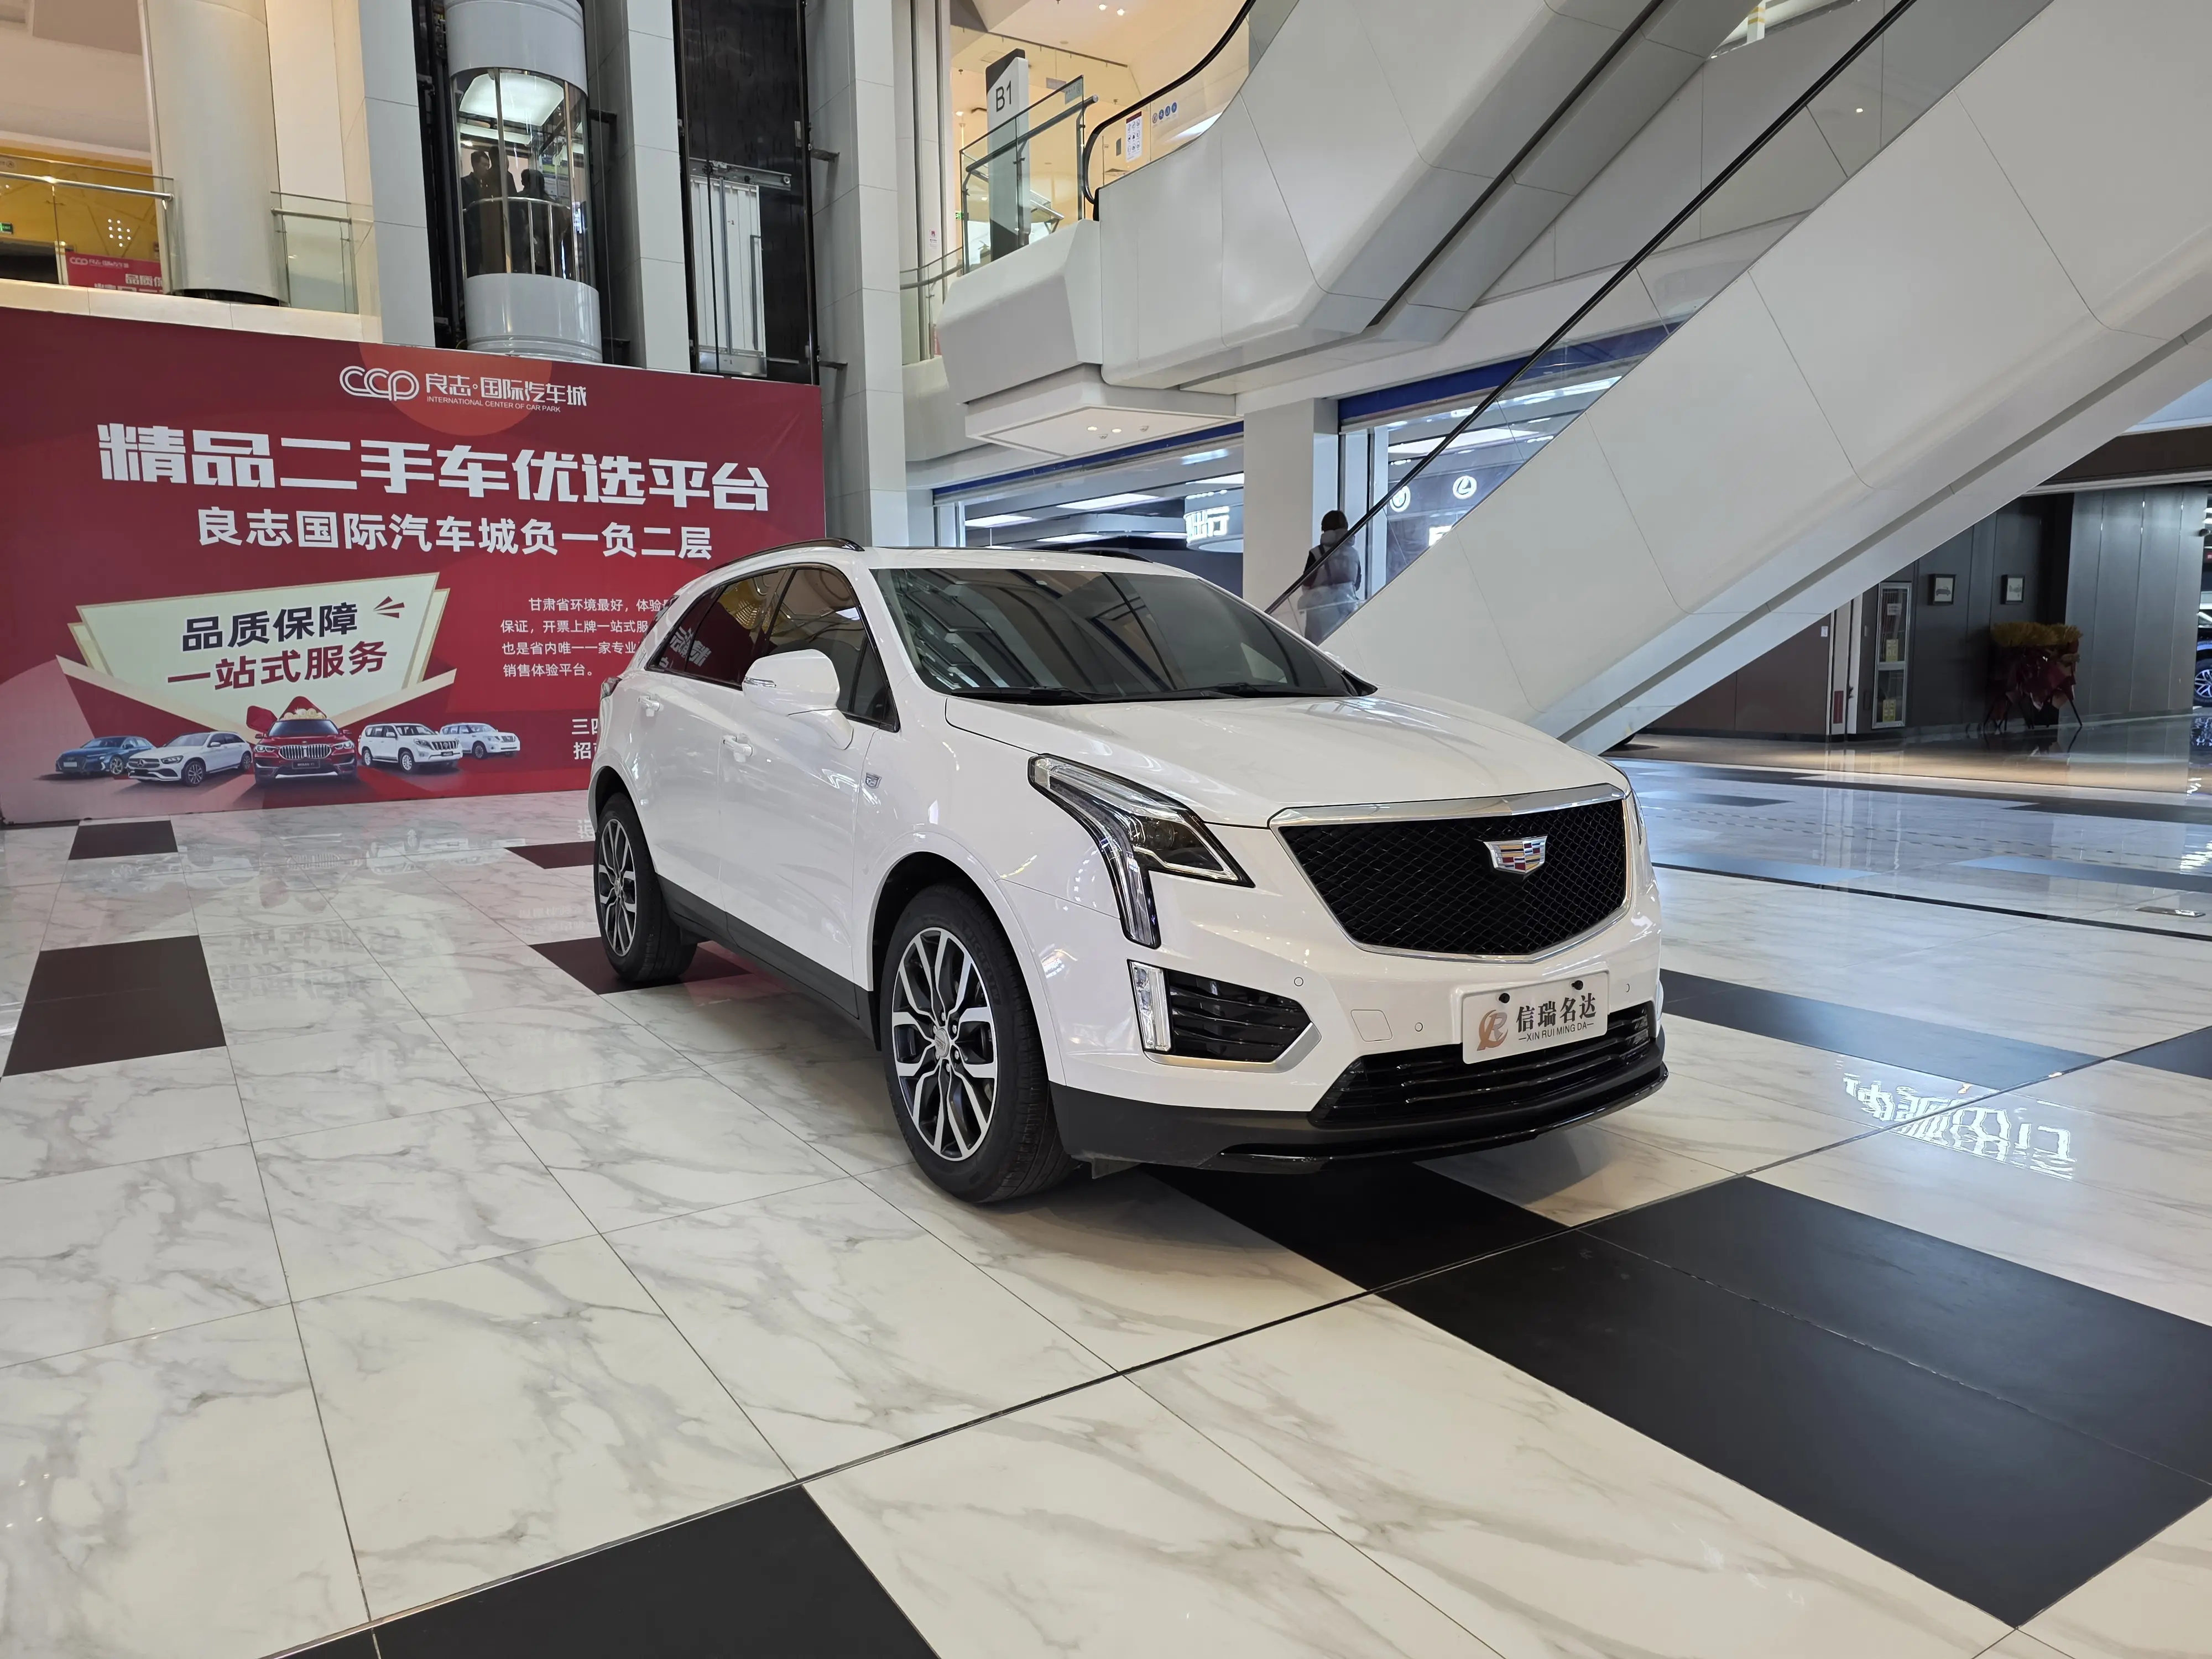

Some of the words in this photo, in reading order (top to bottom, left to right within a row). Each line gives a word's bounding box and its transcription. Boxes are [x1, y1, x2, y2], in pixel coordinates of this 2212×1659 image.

[996, 80, 1011, 112] B1
[426, 396, 483, 406] INTERNATIONAL
[485, 400, 515, 409] CENTER
[97, 422, 769, 512] 精品二手车优选平台
[198, 506, 712, 560] 良志国际汽车城负一负二层
[529, 597, 668, 612] 甘肃省环境最好，体验
[182, 602, 357, 651] 品质保障
[500, 619, 648, 634] 保证，开票上牌一站式服
[502, 641, 640, 655] 也是省内唯一一家专业
[168, 640, 387, 690] 一站式服务
[503, 662, 593, 677] 销售体验平台。
[573, 742, 597, 760] 招
[1516, 993, 1597, 1033] 信瑞名达
[1542, 1029, 1555, 1039] RUI
[1557, 1024, 1575, 1036] MING
